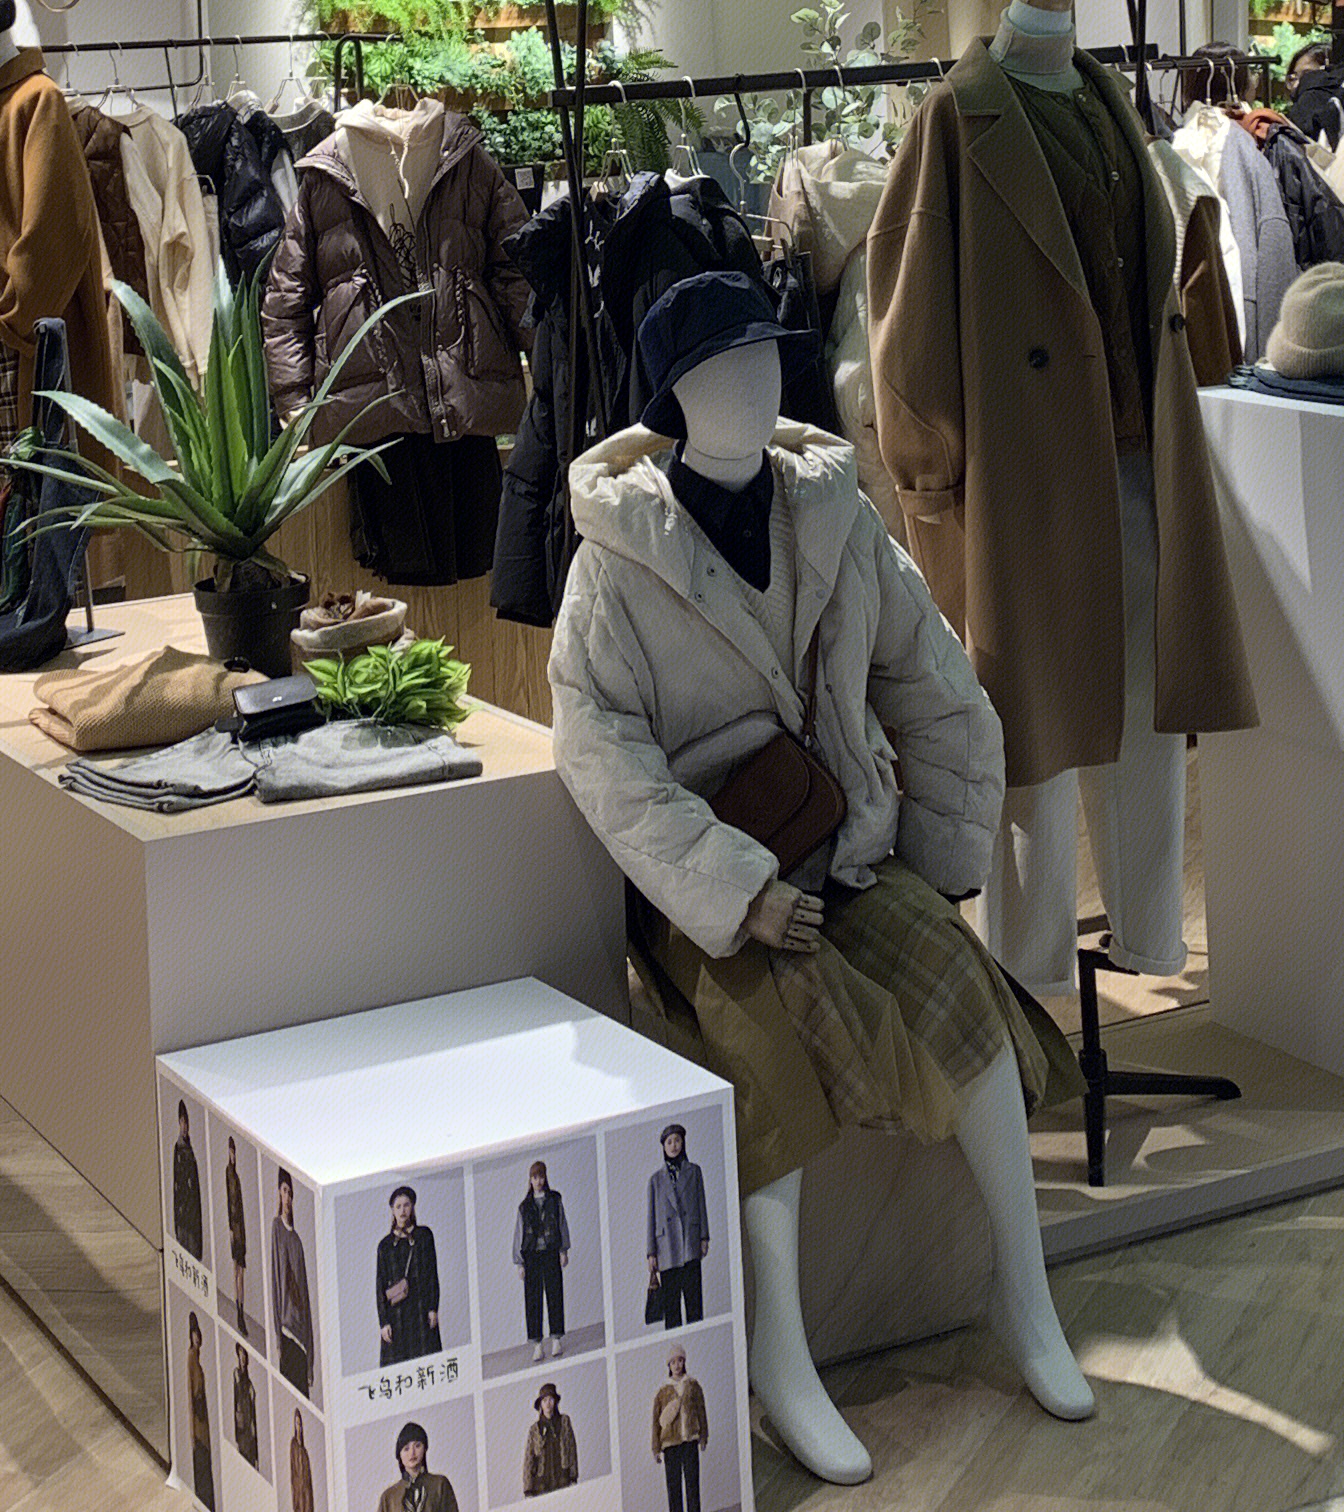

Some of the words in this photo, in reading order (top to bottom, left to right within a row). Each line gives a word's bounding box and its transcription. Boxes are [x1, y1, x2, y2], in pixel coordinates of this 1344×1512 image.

[357, 1357, 459, 1400] 飞鸟和新酒
